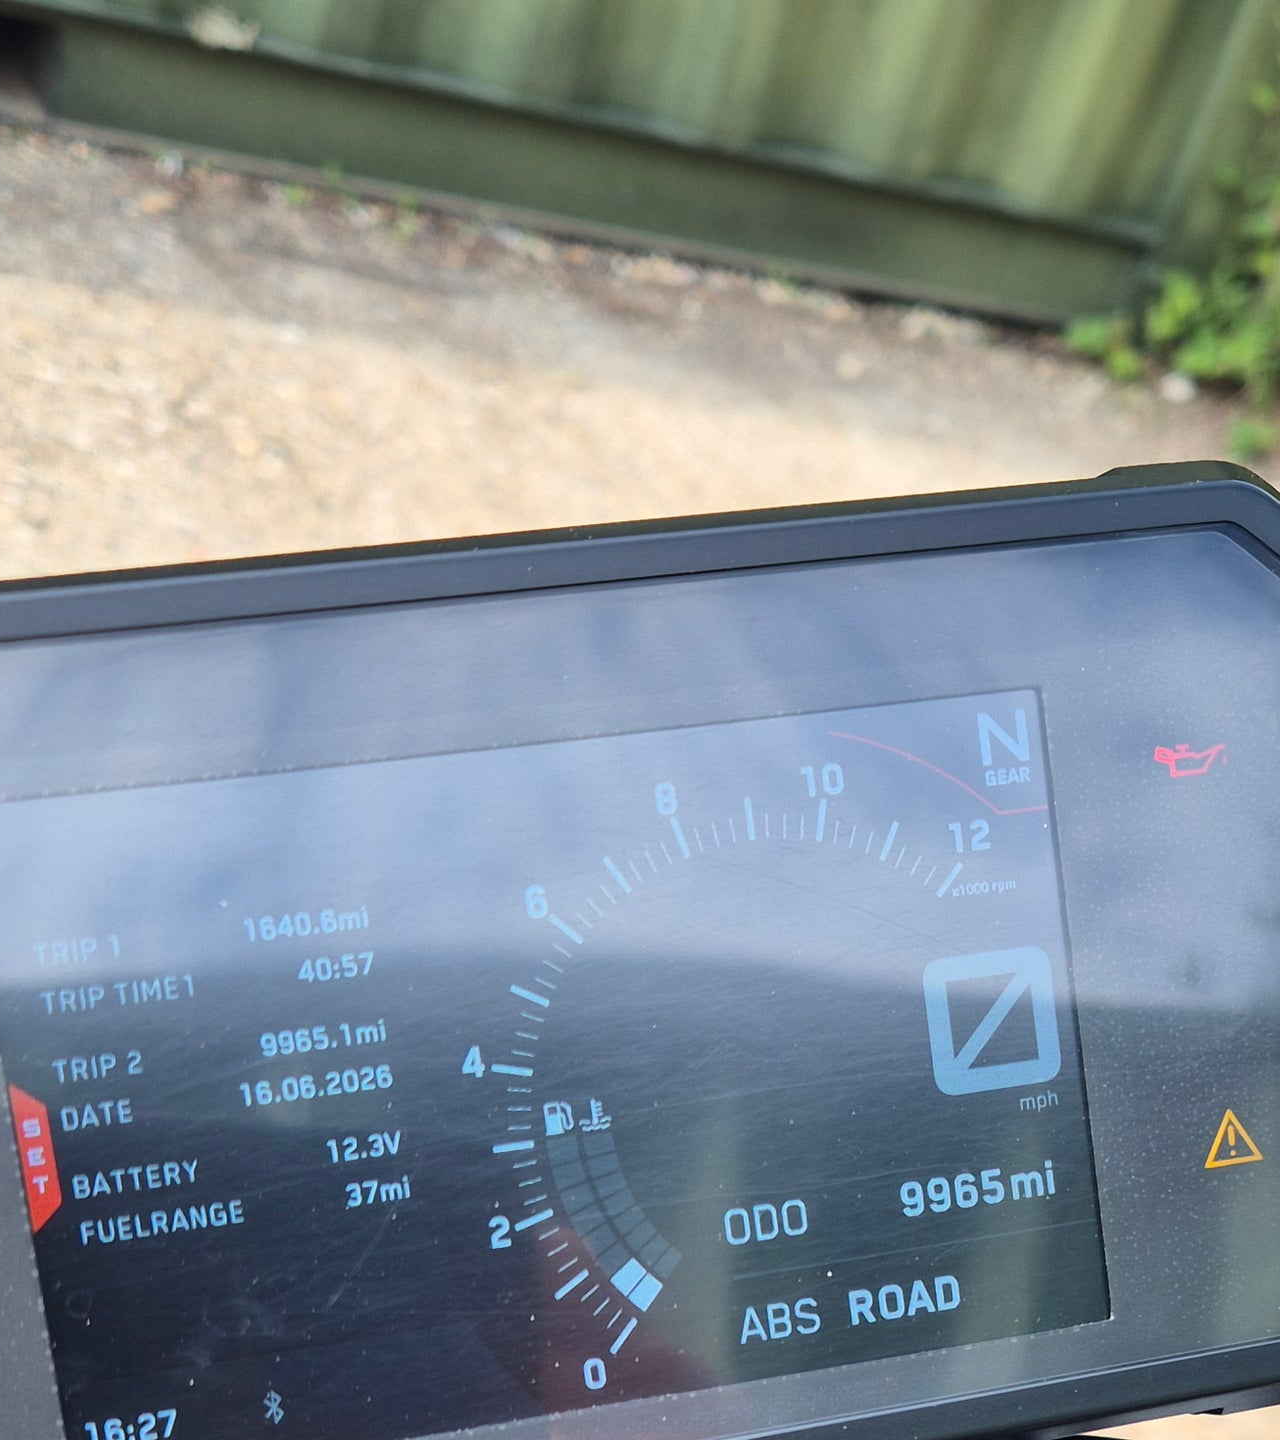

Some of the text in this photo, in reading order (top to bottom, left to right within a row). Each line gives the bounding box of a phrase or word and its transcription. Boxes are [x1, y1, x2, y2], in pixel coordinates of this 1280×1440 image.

[976, 708, 1031, 767] N
[799, 763, 845, 797] 10
[984, 765, 1031, 788] GEAR
[654, 782, 679, 816] 8
[947, 819, 992, 853] 12
[522, 885, 551, 919] 6
[992, 877, 1017, 895] rpm
[32, 933, 121, 967] TRIP 1
[297, 951, 375, 983] 40:57
[39, 984, 105, 1015] TRIP
[259, 1018, 387, 1058] 9965.1mi
[51, 1049, 144, 1084] TRIP 2
[461, 1045, 486, 1078] 4
[239, 1064, 394, 1108] 16.06.2026
[1019, 1089, 1059, 1112] mph
[60, 1098, 134, 1132] DATE
[325, 1129, 402, 1164] 12.3V
[71, 1158, 199, 1200] BATTERY
[345, 1175, 411, 1210] 37mi
[79, 1199, 246, 1246] FUELRANGE
[488, 1215, 513, 1250] 2
[723, 1199, 809, 1247] ODO
[740, 1274, 962, 1345] ABS ROAD
[583, 1357, 607, 1391] 0
